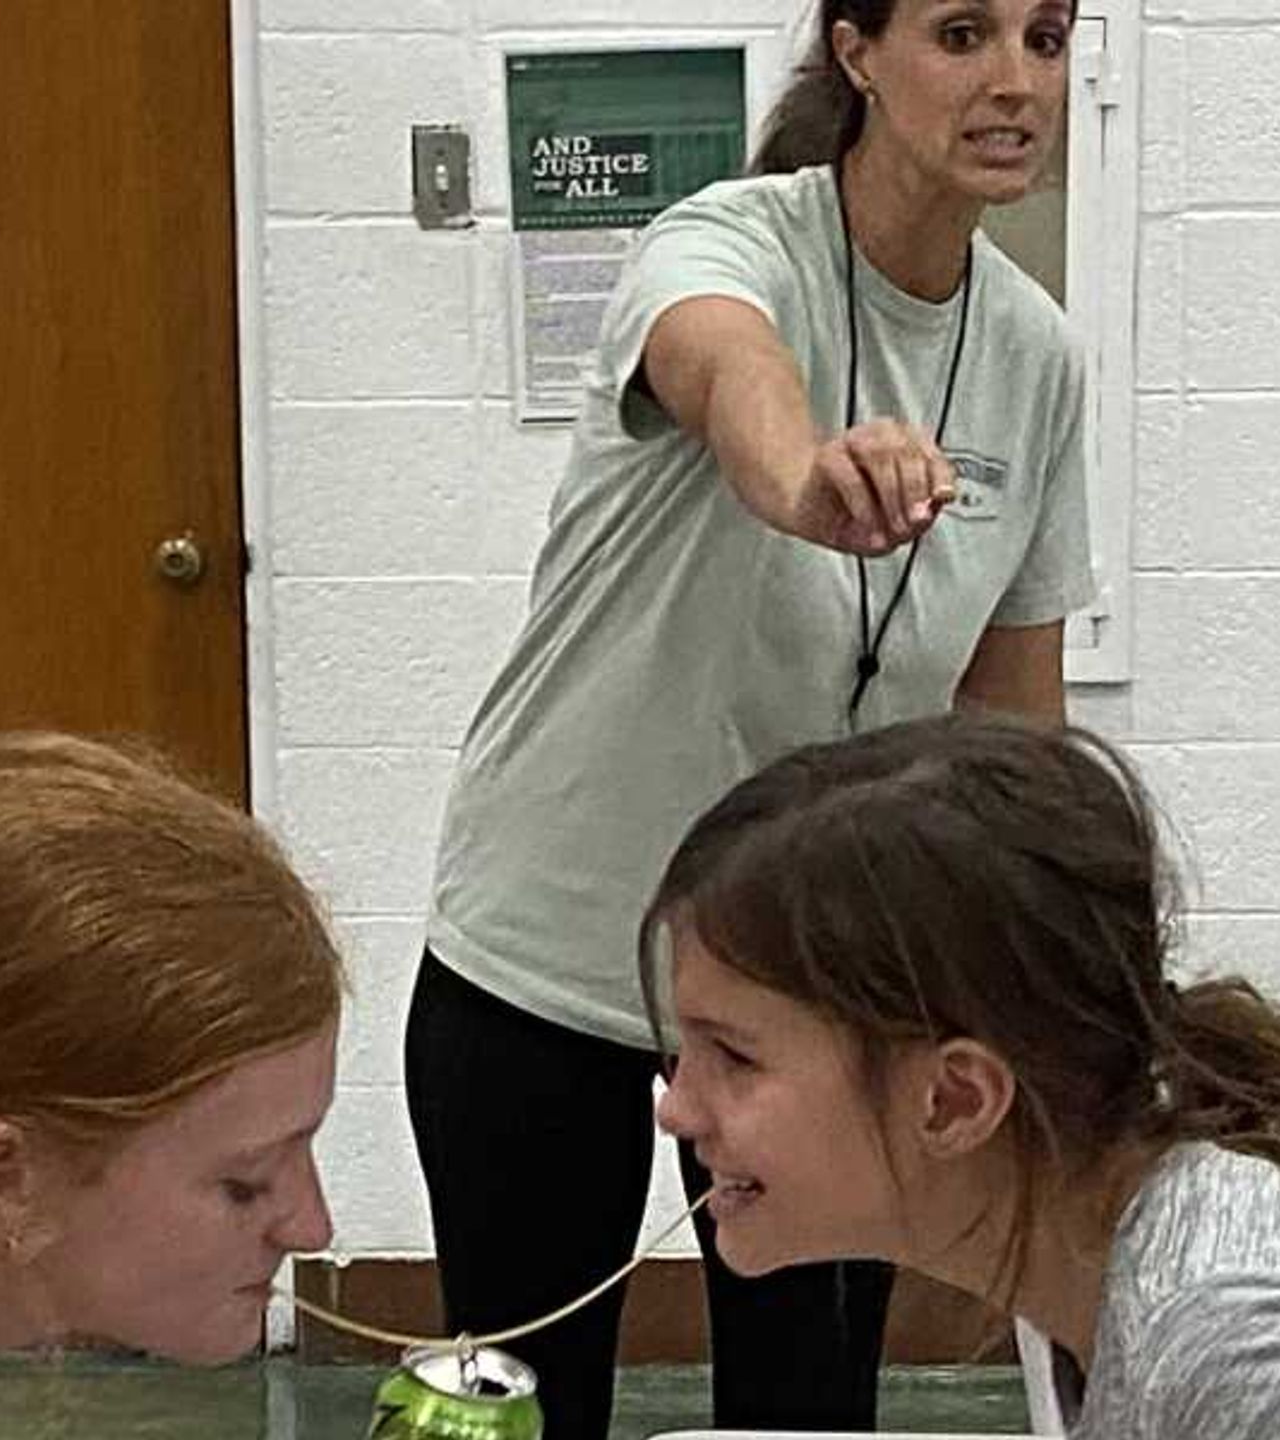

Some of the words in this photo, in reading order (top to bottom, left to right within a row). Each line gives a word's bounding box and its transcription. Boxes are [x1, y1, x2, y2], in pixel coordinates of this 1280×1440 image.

[532, 135, 592, 158] AND
[532, 153, 650, 177] JUSTICE
[566, 178, 619, 198] ALL
